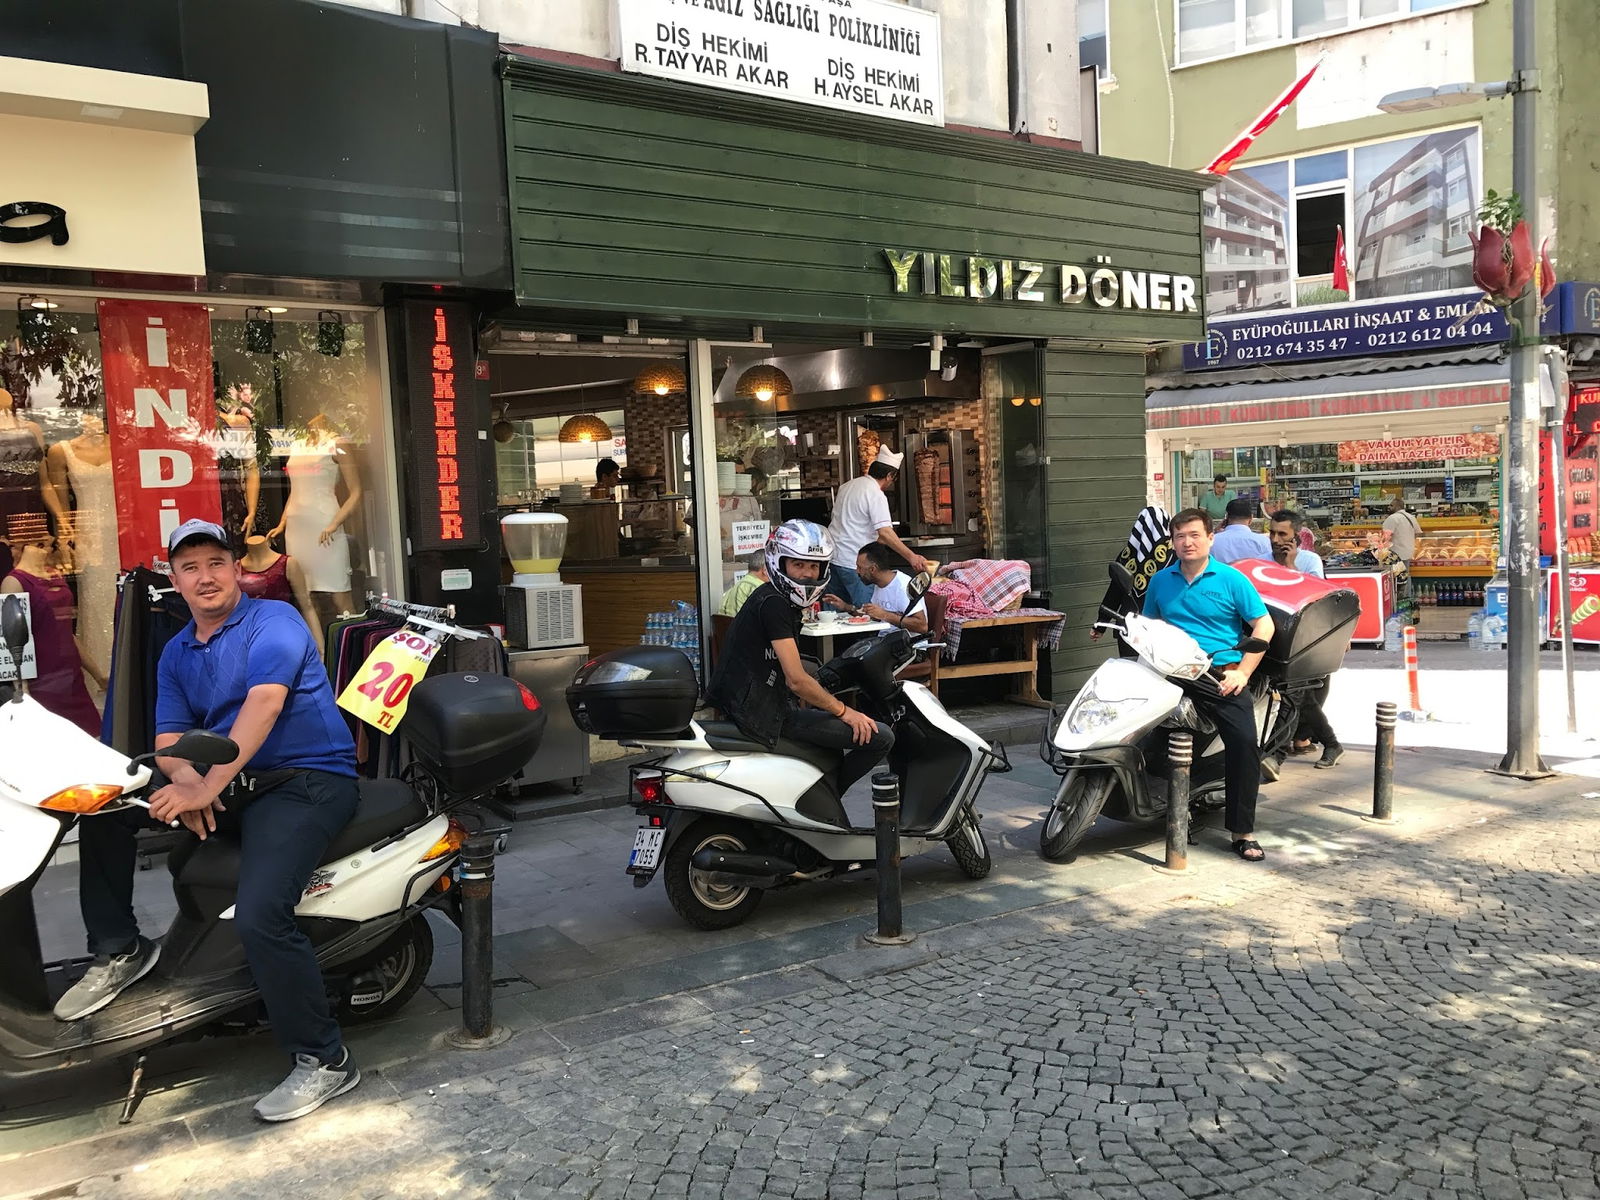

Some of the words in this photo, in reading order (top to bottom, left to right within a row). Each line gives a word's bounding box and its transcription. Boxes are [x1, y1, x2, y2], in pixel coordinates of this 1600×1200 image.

[657, 21, 690, 49] DİŞ
[702, 32, 768, 63] HEKİMİ
[829, 13, 921, 56] POLİKLİNİĞİ
[736, 63, 789, 89] AKAR
[828, 57, 855, 82] DİŞ
[864, 66, 920, 93] HEKİMİ
[890, 93, 934, 116] AKAR
[882, 248, 1045, 303] YILDIZ
[1058, 254, 1198, 313] DÖNER
[1232, 318, 1350, 341] EYÜPOĞULLARI
[1354, 309, 1414, 330] İNŞAAT
[1418, 308, 1431, 321] &
[1237, 345, 1272, 360] 0212
[1276, 341, 1303, 356] 674
[1307, 341, 1325, 353] 35
[1329, 337, 1348, 350] 47
[1368, 331, 1407, 347] 0212
[1411, 328, 1442, 342] 612
[1446, 325, 1468, 339] 04
[1472, 322, 1493, 336] 04
[432, 308, 464, 540] İSKENDER
[1367, 438, 1414, 450] VAKUM
[1416, 435, 1464, 448] YAPILIR
[1401, 449, 1432, 460] TAZE
[1436, 447, 1474, 458] KALIR
[357, 661, 414, 708] 20
[377, 710, 395, 729] TL
[635, 831, 646, 847] 34
[634, 848, 655, 865] 7055
[353, 994, 380, 1003] HONDA
